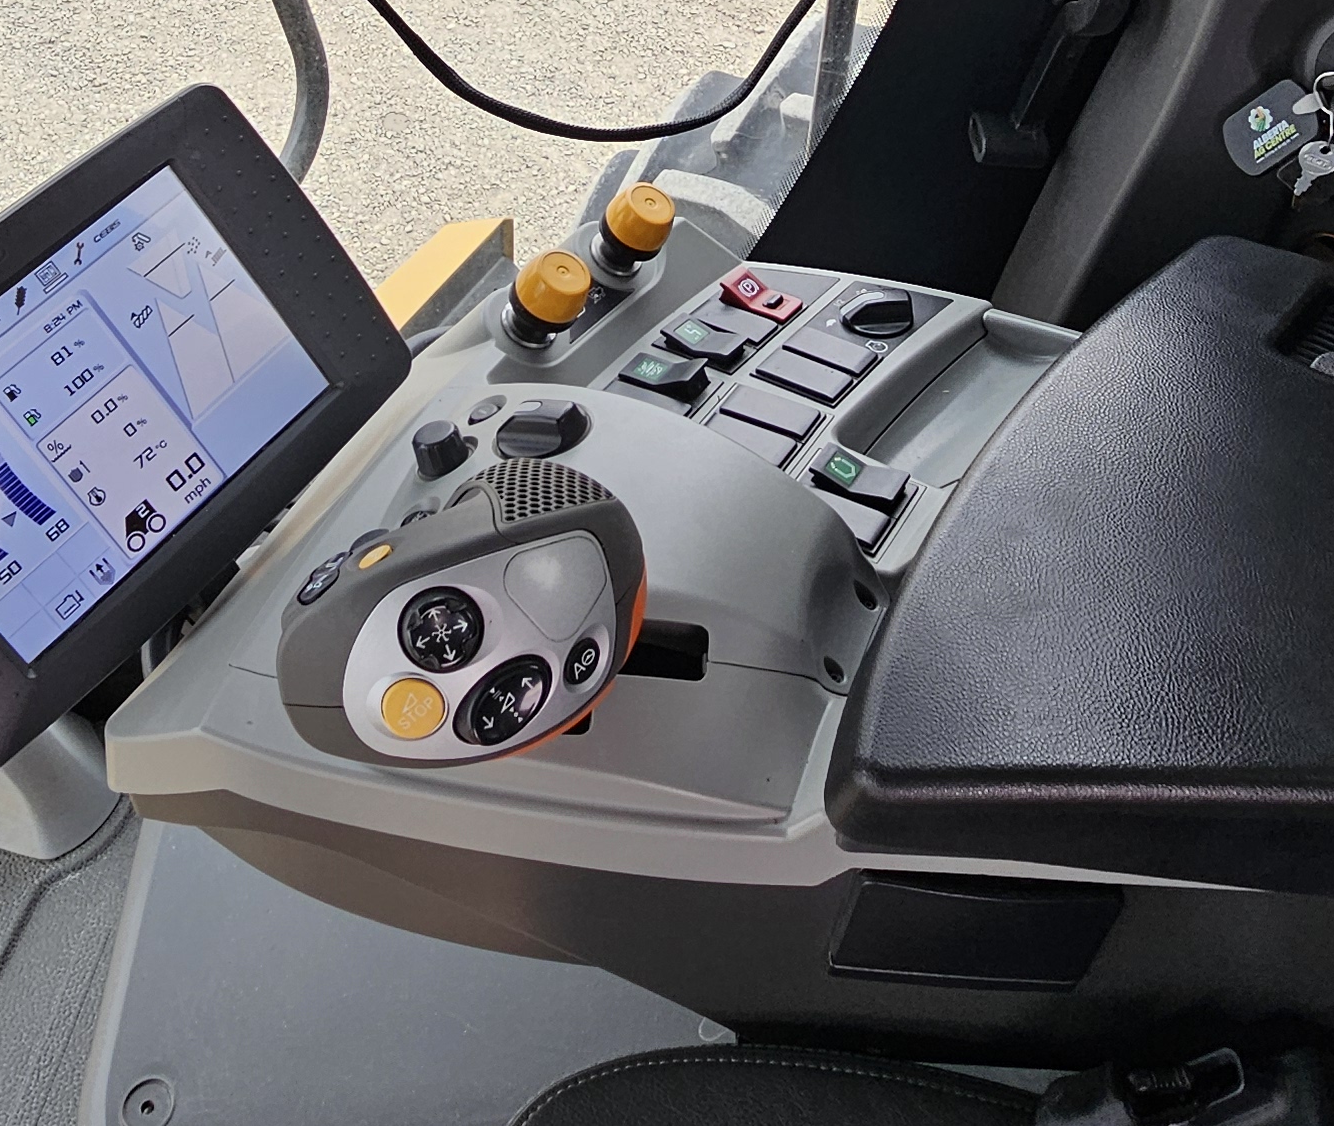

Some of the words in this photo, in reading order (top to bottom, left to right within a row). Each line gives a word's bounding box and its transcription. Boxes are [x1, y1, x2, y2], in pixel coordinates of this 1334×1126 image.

[1252, 119, 1290, 150] ALBERTA
[1254, 146, 1267, 159] AG
[1264, 123, 1298, 151] CENTRE
[43, 312, 67, 335] 8:24
[66, 299, 84, 317] PM
[50, 345, 74, 367] 81
[63, 367, 95, 397] 100
[90, 397, 118, 425] 0.0
[123, 422, 137, 437] 0
[132, 445, 158, 470] 72
[165, 451, 206, 492] 0.0
[183, 476, 212, 505] mph
[45, 517, 70, 542] 68
[397, 695, 435, 730] STOP
